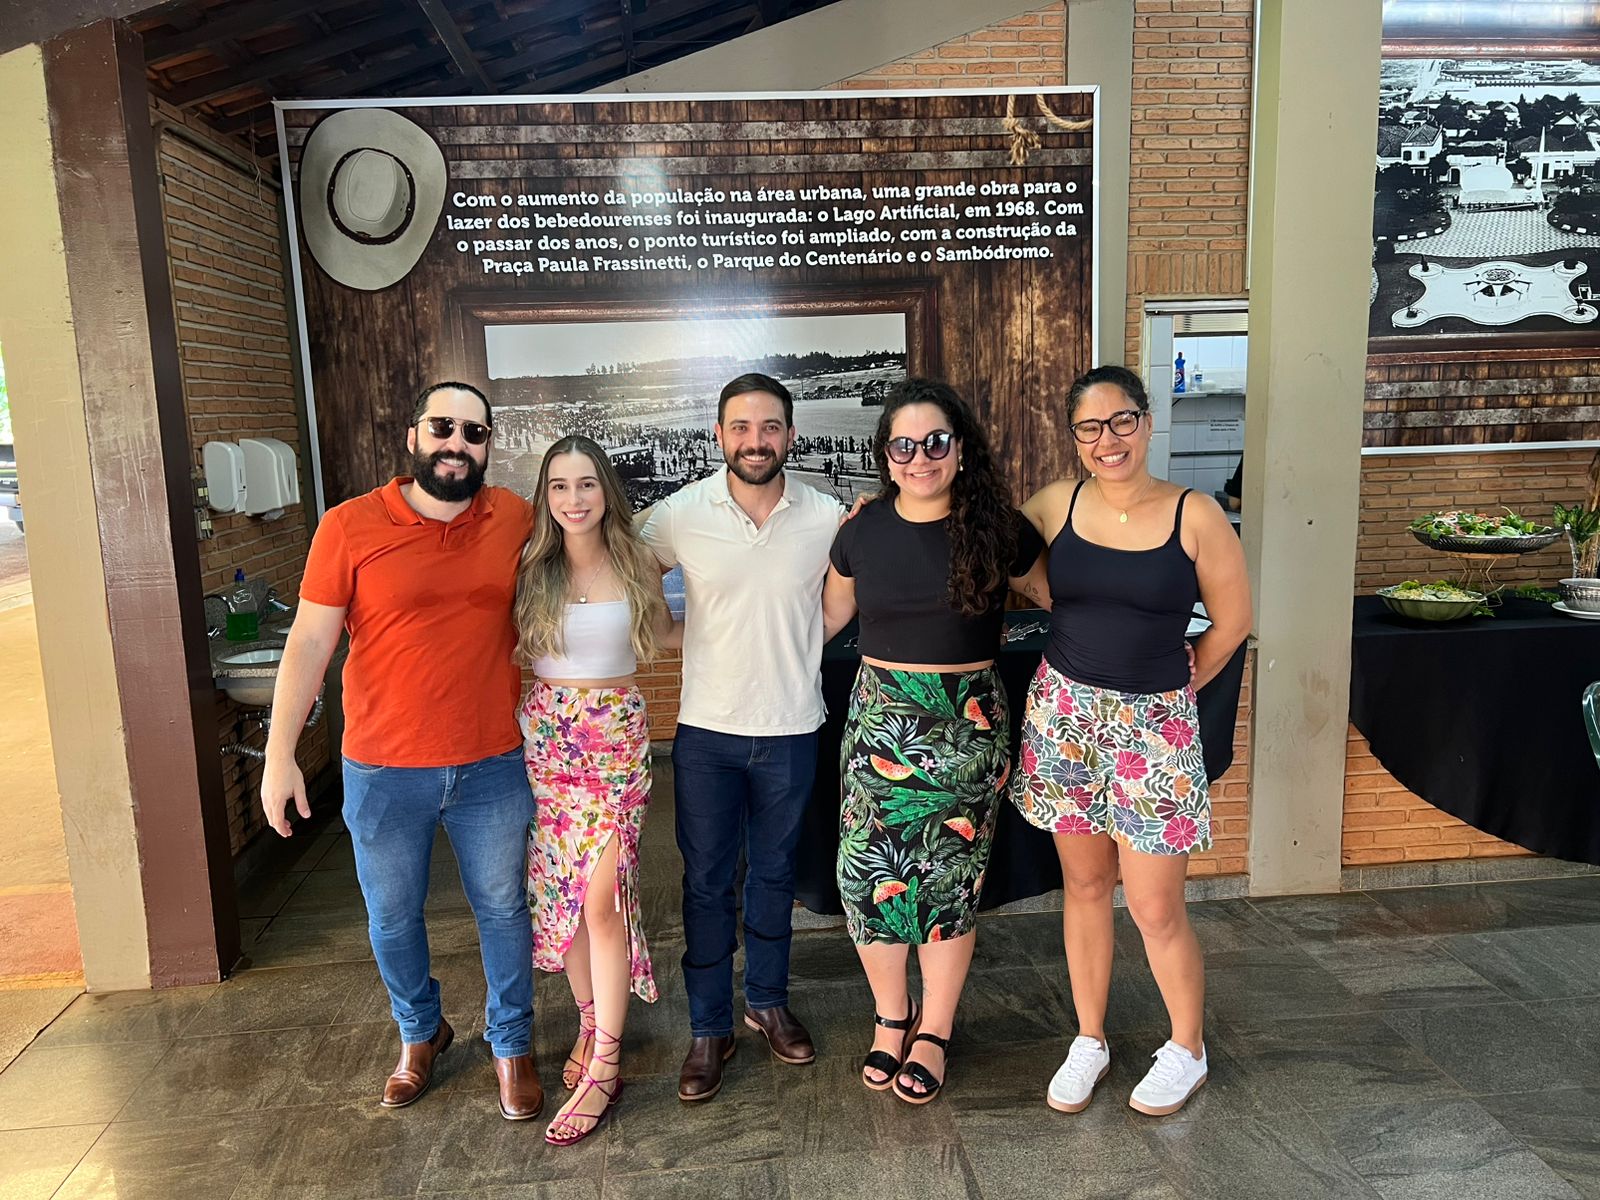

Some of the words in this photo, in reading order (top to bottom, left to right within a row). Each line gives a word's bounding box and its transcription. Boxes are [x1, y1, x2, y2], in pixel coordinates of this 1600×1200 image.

[452, 191, 497, 208] Com
[500, 194, 513, 207] o
[517, 190, 600, 207] aumento
[604, 189, 627, 206] da
[630, 187, 726, 208] população
[729, 190, 753, 202] na
[756, 186, 796, 202] área
[799, 185, 868, 201] urbana,
[871, 186, 911, 199] uma
[914, 181, 976, 202] grande
[979, 180, 1020, 196] obra
[1023, 182, 1062, 198] para
[1065, 181, 1077, 193] o
[446, 214, 493, 230] lazer
[496, 213, 531, 229] dos
[533, 209, 673, 228] bebedourenses
[676, 209, 701, 226] foi
[704, 207, 813, 228] inaugurada:
[817, 210, 829, 222] o
[832, 206, 876, 225] Lago
[879, 203, 961, 221] Artificial,
[964, 205, 992, 218] em
[995, 200, 1040, 217] 1968.
[1044, 199, 1084, 215] Com
[456, 240, 469, 252] o
[472, 238, 533, 256] passar
[537, 235, 571, 251] dos
[574, 237, 624, 251] anos,
[627, 236, 640, 249] o
[643, 233, 698, 252] ponto
[701, 230, 777, 247] turístico
[780, 229, 805, 245] foi
[809, 227, 896, 247] ampliado,
[900, 228, 938, 242] com
[941, 228, 952, 240] a
[955, 221, 1052, 241] construção
[1056, 221, 1076, 235] da
[482, 258, 535, 277] Praça
[537, 256, 590, 273] Paula
[592, 254, 693, 272] Frassinetti,
[696, 257, 709, 269] o
[712, 253, 775, 272] Parque
[778, 251, 802, 267] do
[805, 248, 903, 266] Centenário
[906, 251, 917, 263] e
[920, 250, 932, 263] o
[935, 244, 1054, 262] Sambódromo.
